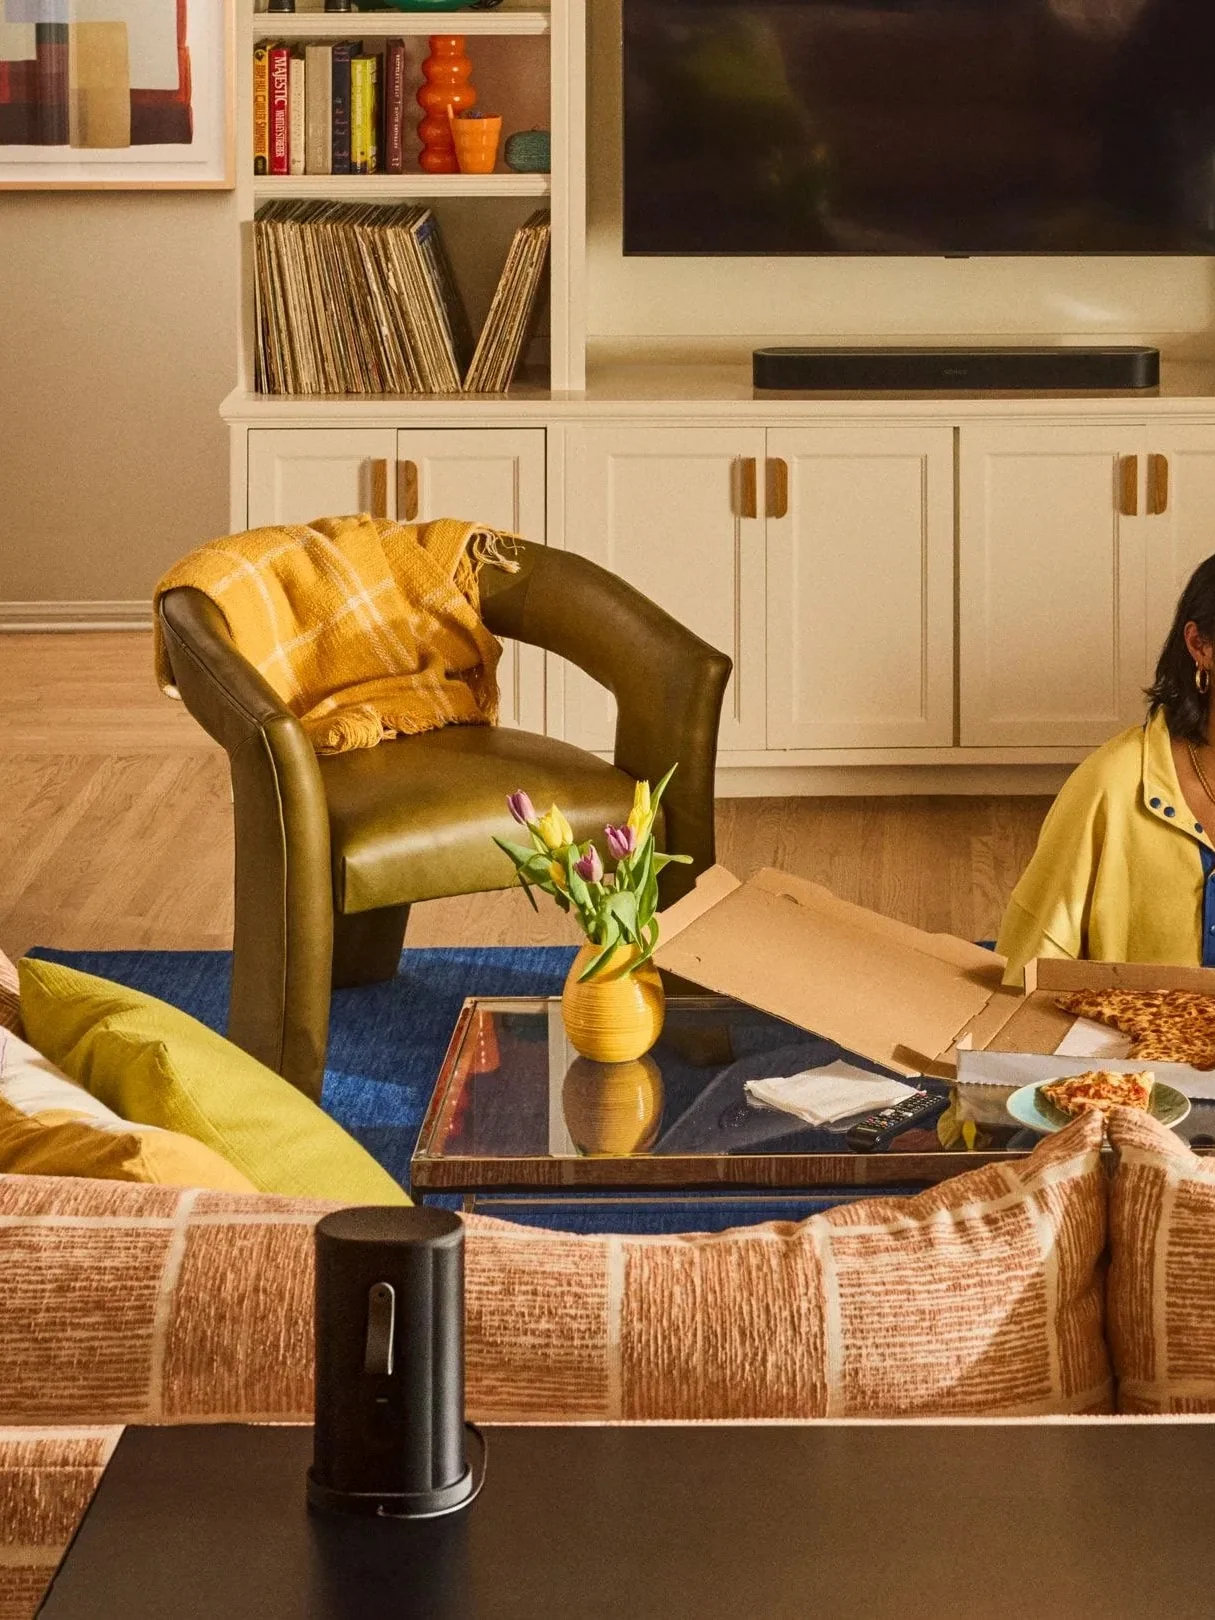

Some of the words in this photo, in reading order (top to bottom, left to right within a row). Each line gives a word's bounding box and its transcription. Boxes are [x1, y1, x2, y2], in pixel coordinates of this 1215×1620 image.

[272, 56, 288, 105] MAJESTIC
[275, 109, 285, 132] WHITLEY
[275, 132, 285, 157] STRIEBER
